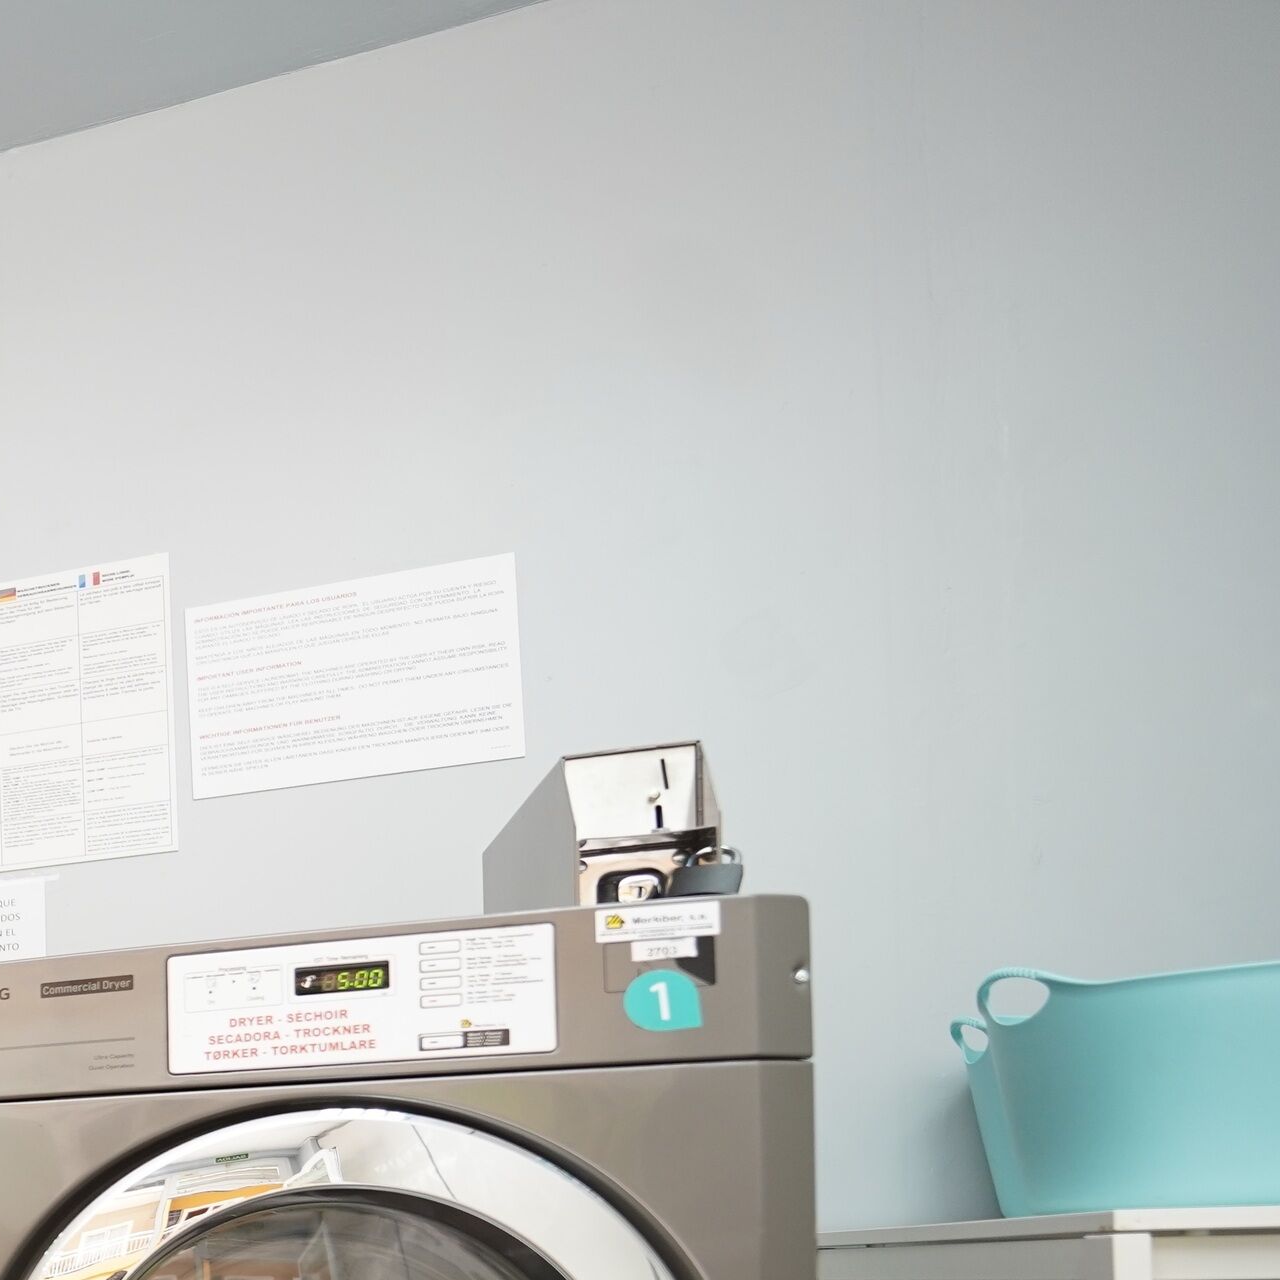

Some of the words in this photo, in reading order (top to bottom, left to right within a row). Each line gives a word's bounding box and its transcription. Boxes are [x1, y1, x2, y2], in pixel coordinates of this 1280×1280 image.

[321, 591, 356, 602] USUARIOS
[256, 660, 301, 672] INFORMATION
[304, 714, 340, 724] BENUTZER
[0, 912, 21, 923] DOS
[5, 928, 16, 937] EL
[42, 981, 100, 996] Commercial
[102, 978, 132, 991] Dryer
[649, 981, 671, 1020] 1
[229, 1015, 273, 1028] DRYER
[208, 1031, 281, 1046] SECADORA
[294, 1023, 371, 1039] TROCKNER
[204, 1048, 258, 1061] TØRKER
[271, 1039, 377, 1056] TORKTUMLARE
